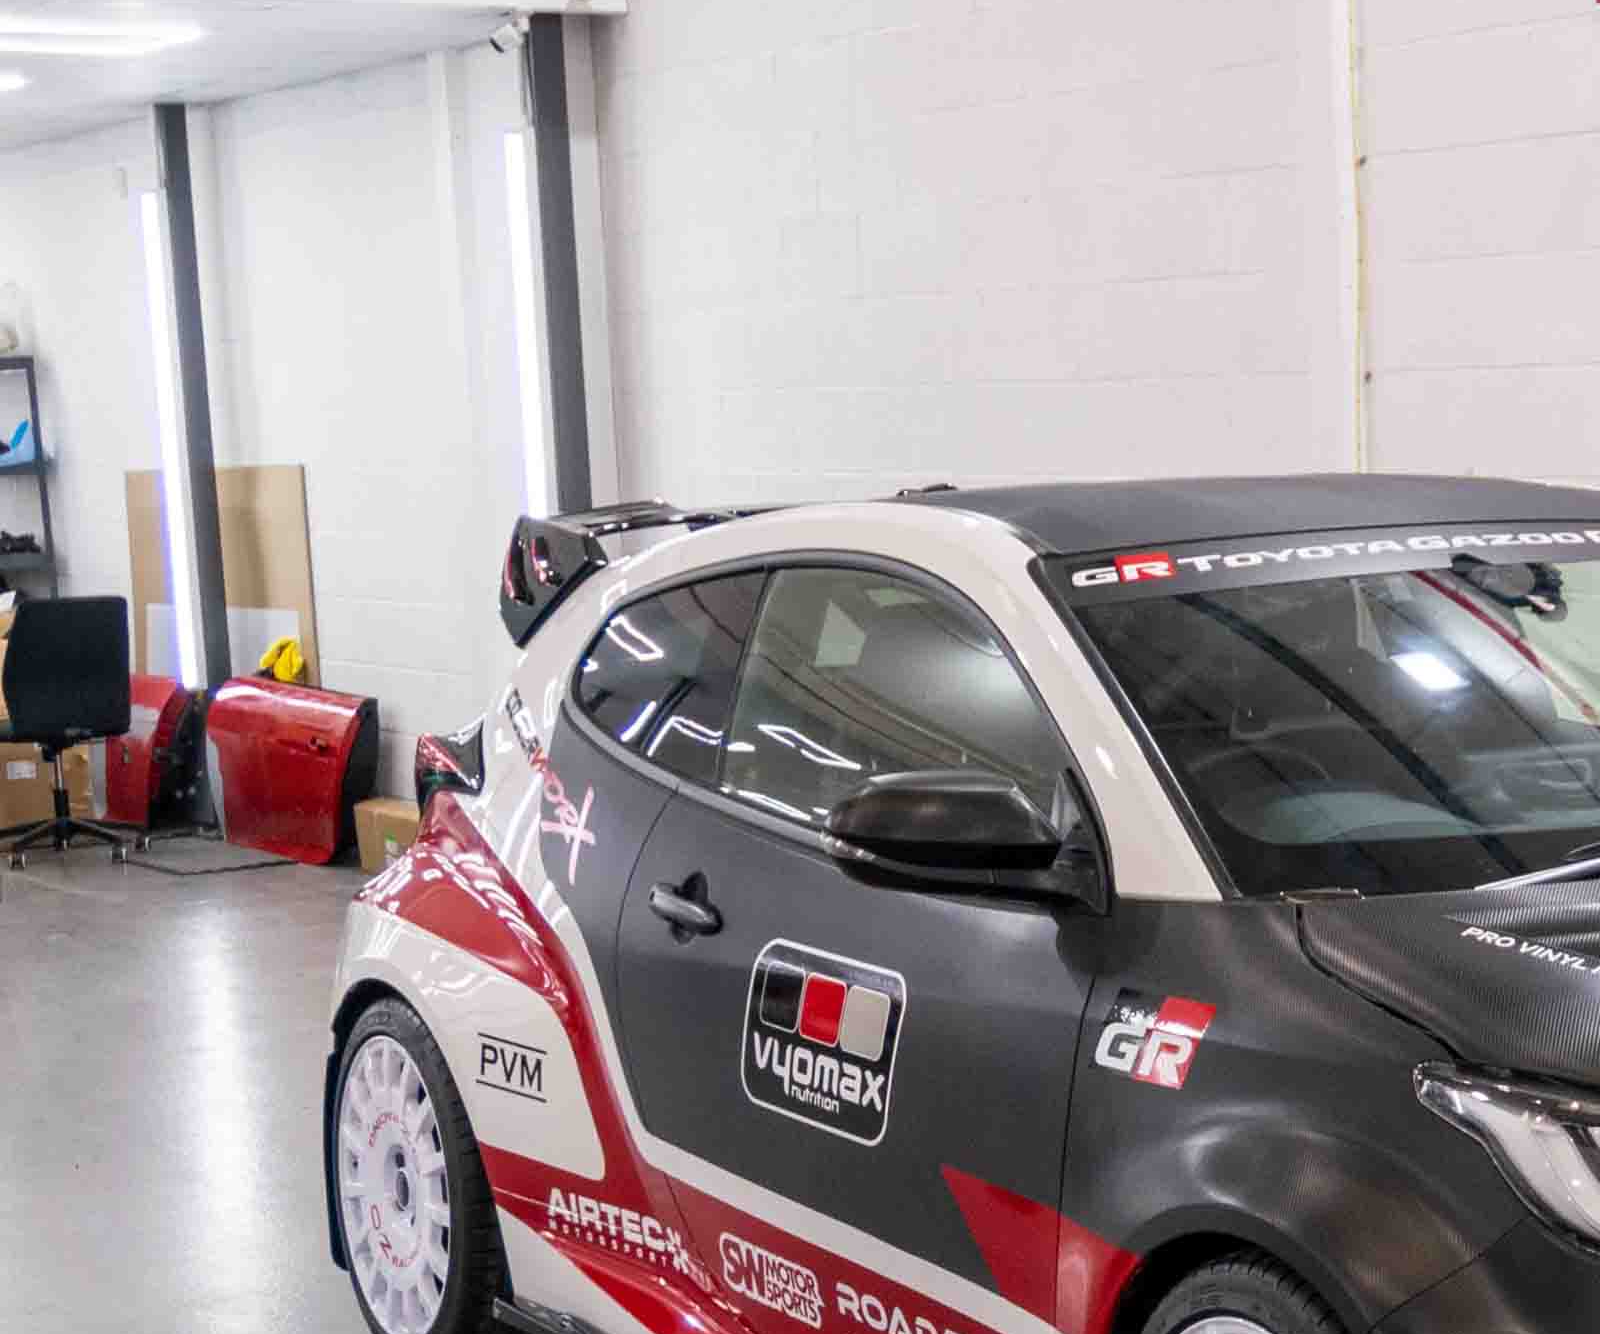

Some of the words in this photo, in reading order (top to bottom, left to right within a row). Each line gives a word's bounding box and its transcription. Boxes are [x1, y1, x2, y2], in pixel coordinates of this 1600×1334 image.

[1071, 559, 1175, 588] GR
[1177, 541, 1405, 572] TOYOTA
[1406, 531, 1584, 551] GAZOO
[1461, 926, 1516, 948] PRO
[1519, 940, 1587, 970] VINYL
[481, 1043, 542, 1092] PVM
[1095, 1022, 1193, 1085] GR
[791, 1084, 841, 1114] nutrition
[547, 1187, 666, 1253] AIRTEC
[766, 1257, 818, 1300] MOTOR
[766, 1279, 819, 1323] SPORTS
